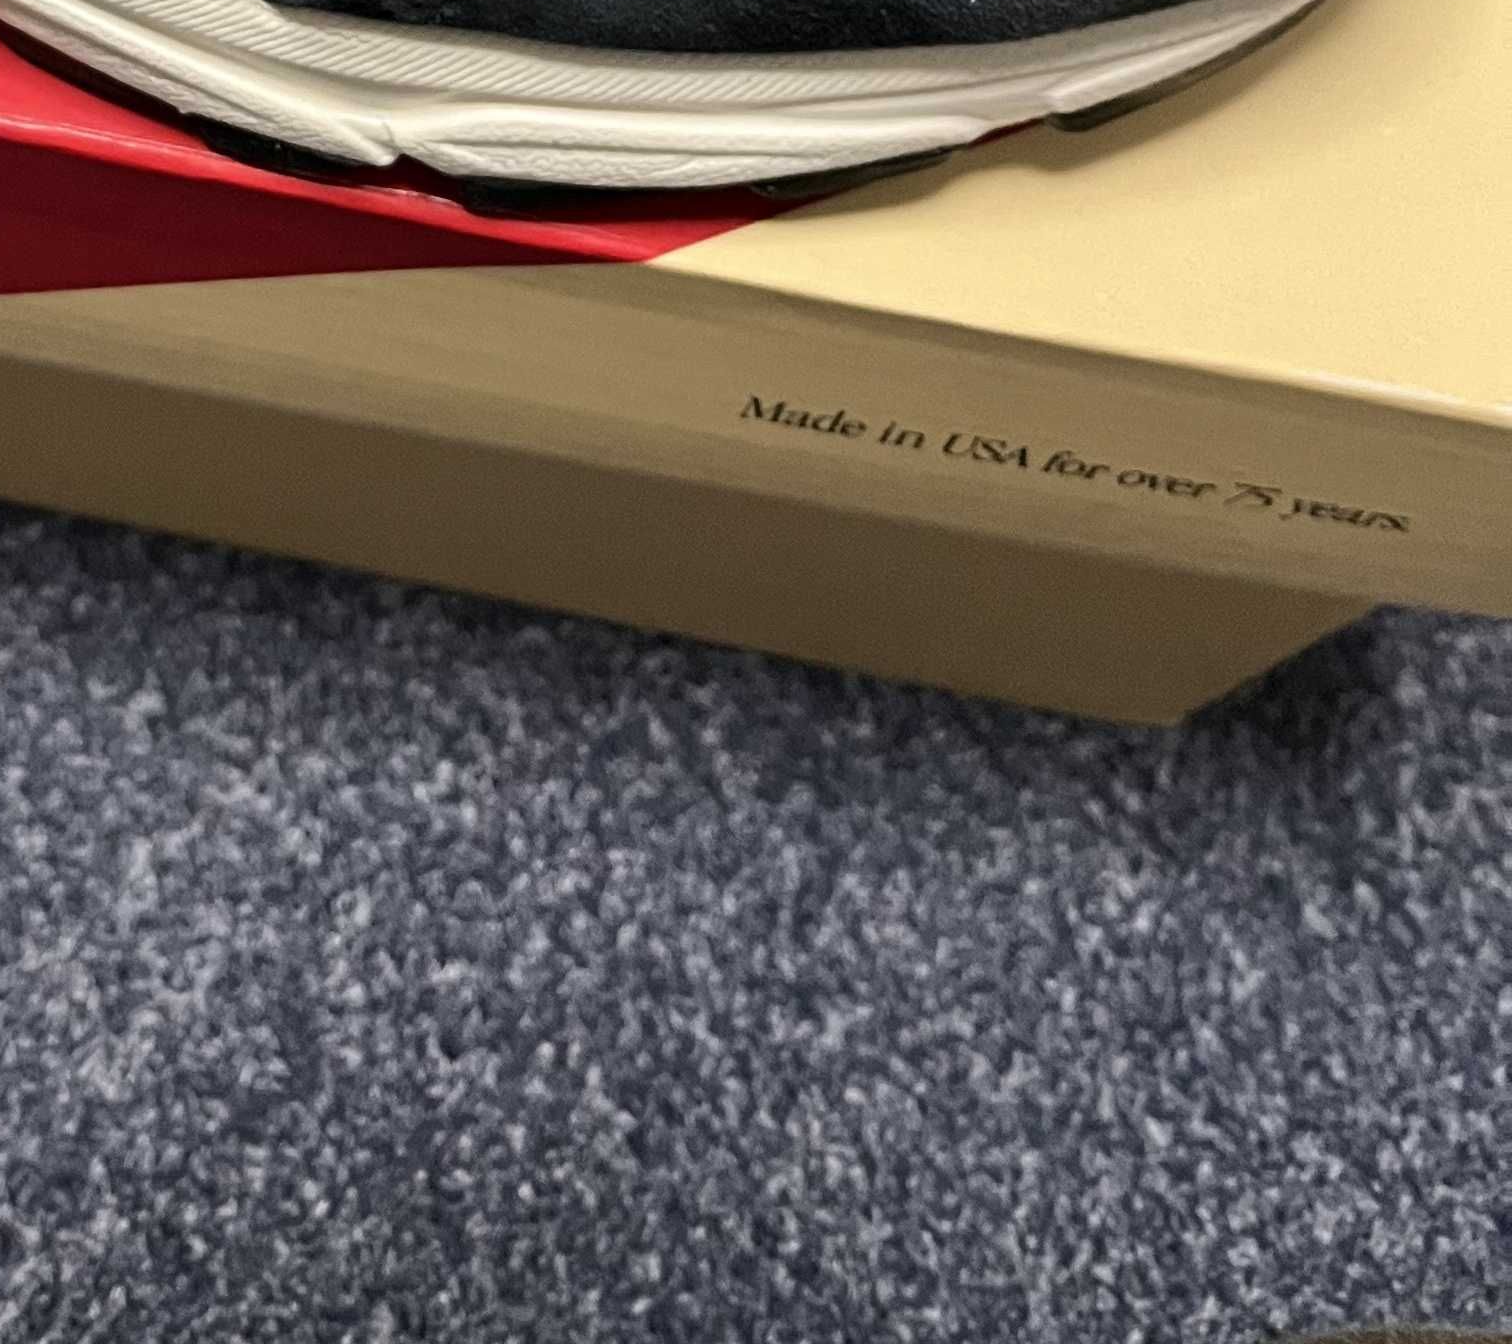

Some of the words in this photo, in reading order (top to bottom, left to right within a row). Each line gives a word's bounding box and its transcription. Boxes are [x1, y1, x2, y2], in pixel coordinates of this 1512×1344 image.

[740, 394, 868, 438] Made
[878, 421, 926, 450] in
[942, 432, 1029, 469] USA
[1040, 449, 1111, 480] for
[1116, 468, 1217, 499] over
[1222, 481, 1283, 507] 75
[1278, 497, 1410, 533] years
